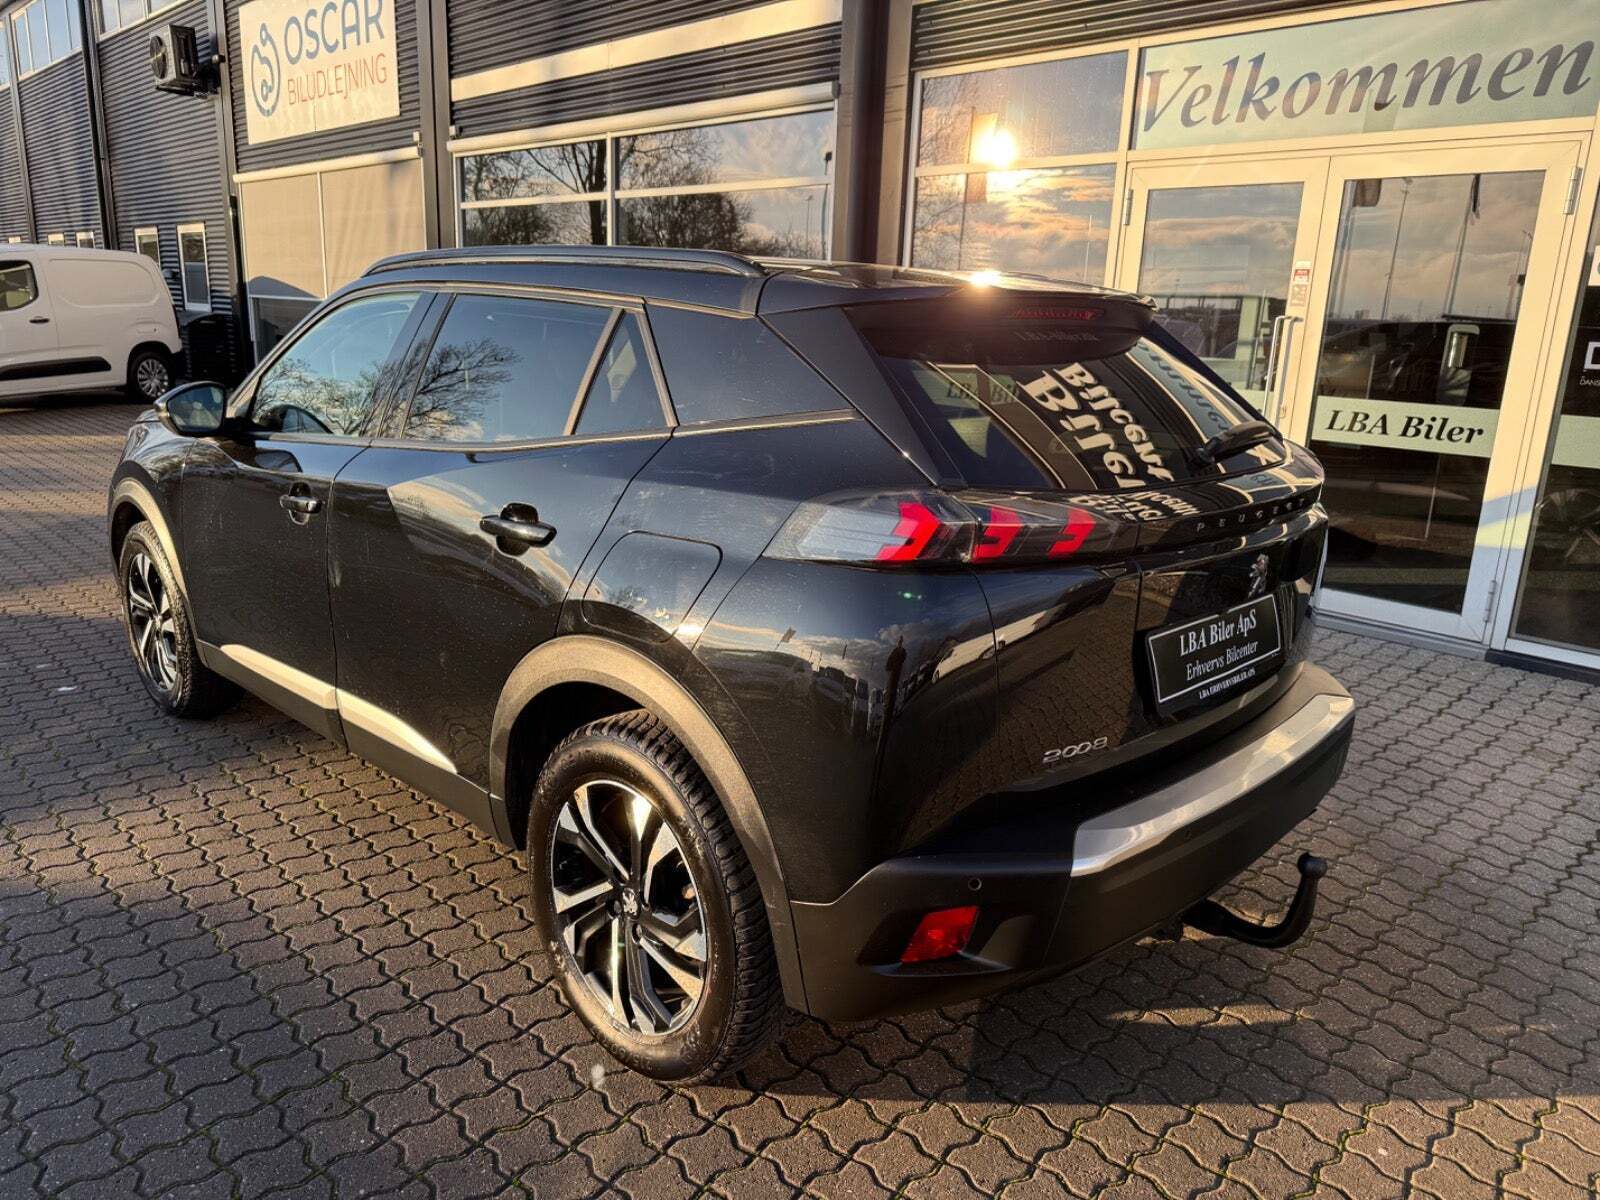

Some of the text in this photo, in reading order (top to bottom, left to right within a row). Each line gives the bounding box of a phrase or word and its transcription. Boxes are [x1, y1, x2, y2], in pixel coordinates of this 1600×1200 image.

[284, 0, 384, 65] OSCAR
[288, 53, 387, 105] BILUDLEJNING
[1143, 39, 1595, 132] Velkommen
[1325, 409, 1484, 444] LBA Biler
[1196, 498, 1305, 532] PEUGEOT
[1180, 609, 1256, 656] LBA Biler ApS
[1186, 641, 1259, 681] Erhvervs Bilcenter
[1042, 736, 1108, 764] 2008
